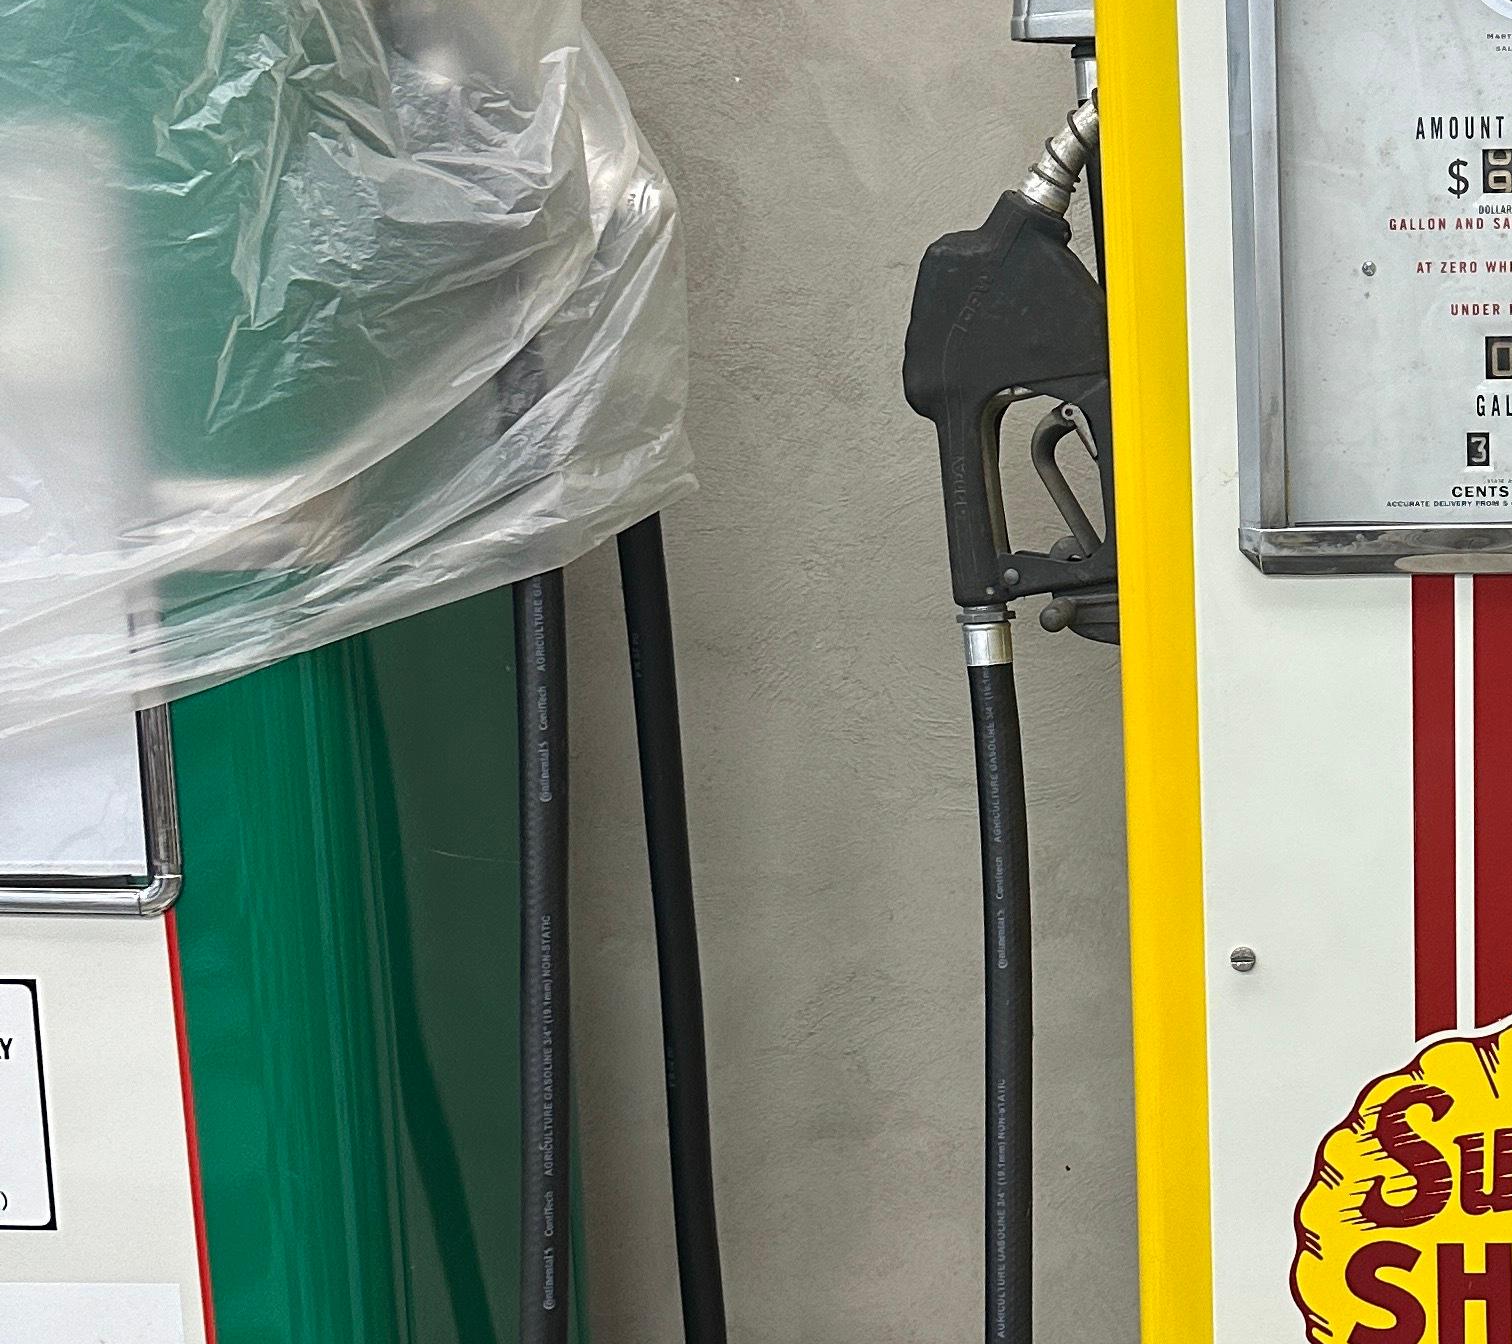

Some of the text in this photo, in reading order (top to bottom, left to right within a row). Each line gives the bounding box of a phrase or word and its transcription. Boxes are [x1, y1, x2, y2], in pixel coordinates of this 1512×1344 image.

[1415, 115, 1505, 140] AMOUNT
[1447, 158, 1470, 200] $
[1389, 218, 1446, 231] GALLON
[1455, 217, 1484, 231] AND
[1416, 261, 1433, 274] AT
[1440, 261, 1477, 274] ZERO
[1450, 303, 1500, 316] UNDER
[1451, 485, 1509, 498] CENTS
[534, 599, 547, 672] AGRICULTURE
[540, 915, 551, 977] NON-STATIC
[543, 1047, 553, 1101] GASOLINE
[996, 1078, 1006, 1139] NON-STATIC
[542, 1102, 554, 1176] AGRICULTURE
